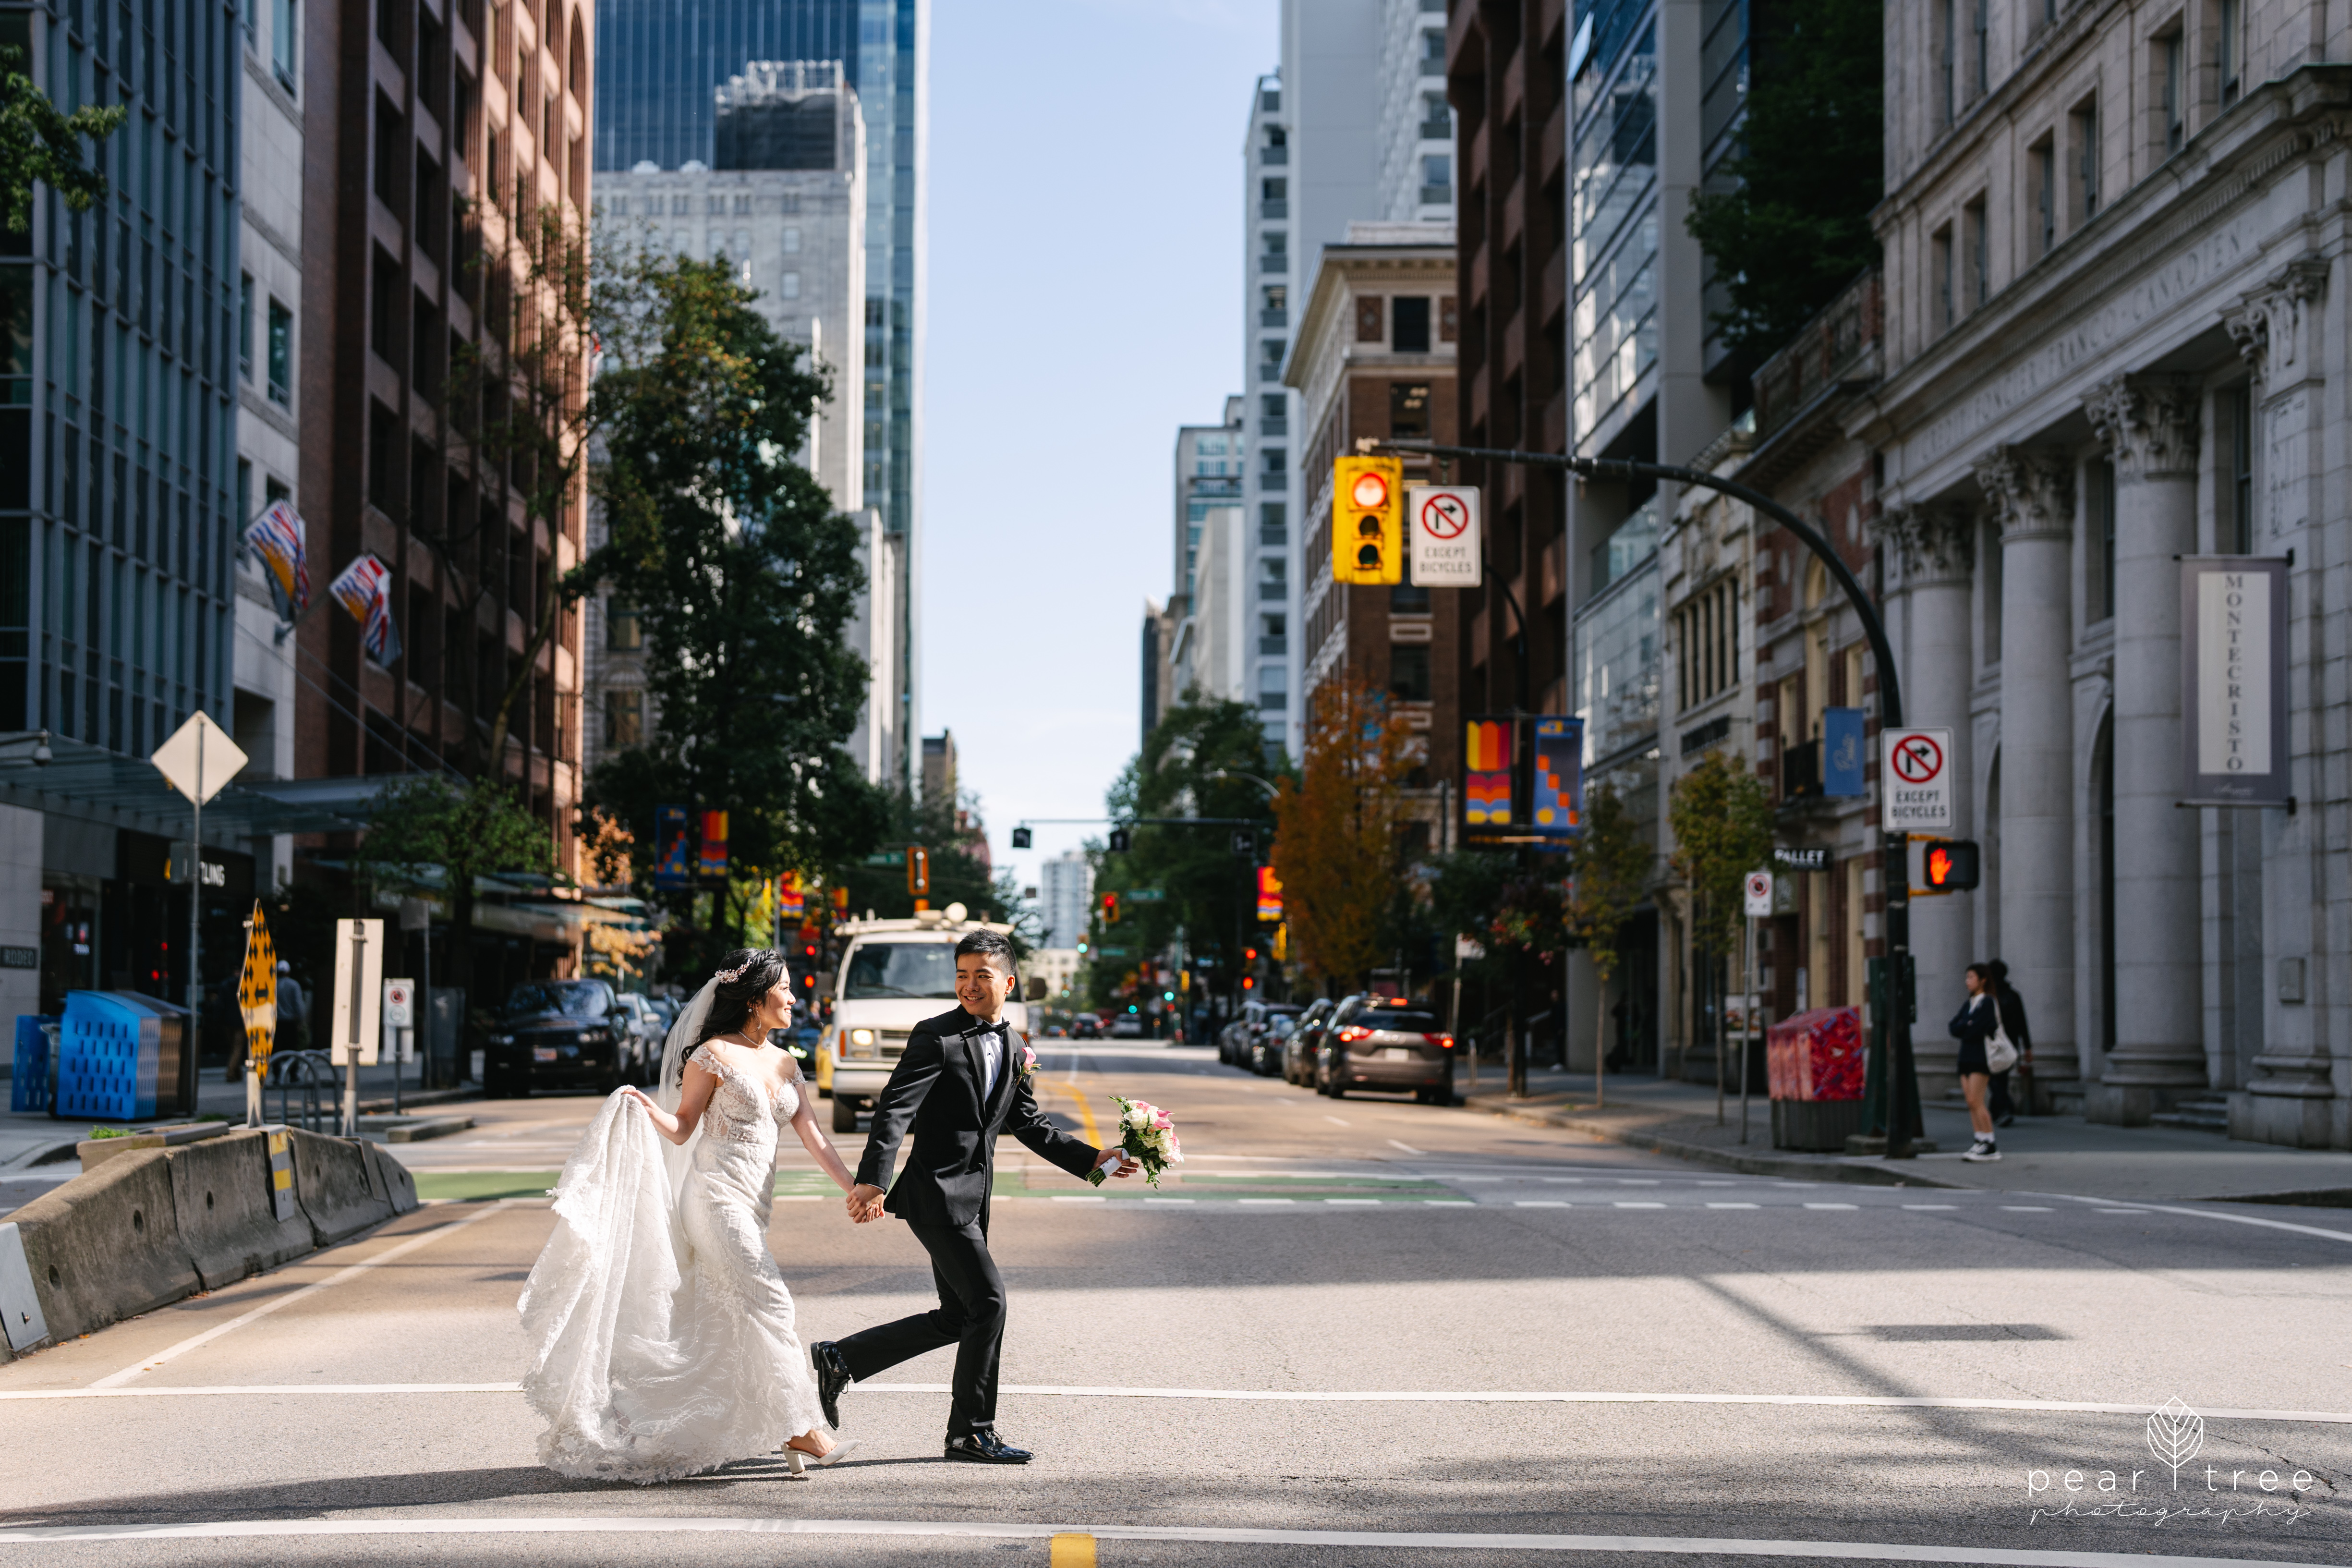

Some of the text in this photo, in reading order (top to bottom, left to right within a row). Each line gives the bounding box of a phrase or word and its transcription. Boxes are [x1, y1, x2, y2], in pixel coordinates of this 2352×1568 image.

[1425, 547, 1466, 558] EXCEPT
[1420, 562, 1472, 573] BICYCLES
[2225, 574, 2243, 771] MONTECRISTO
[1896, 790, 1939, 803] EXCEPT
[1892, 805, 1946, 818] BICYCLES
[1774, 849, 1825, 863] PALLET
